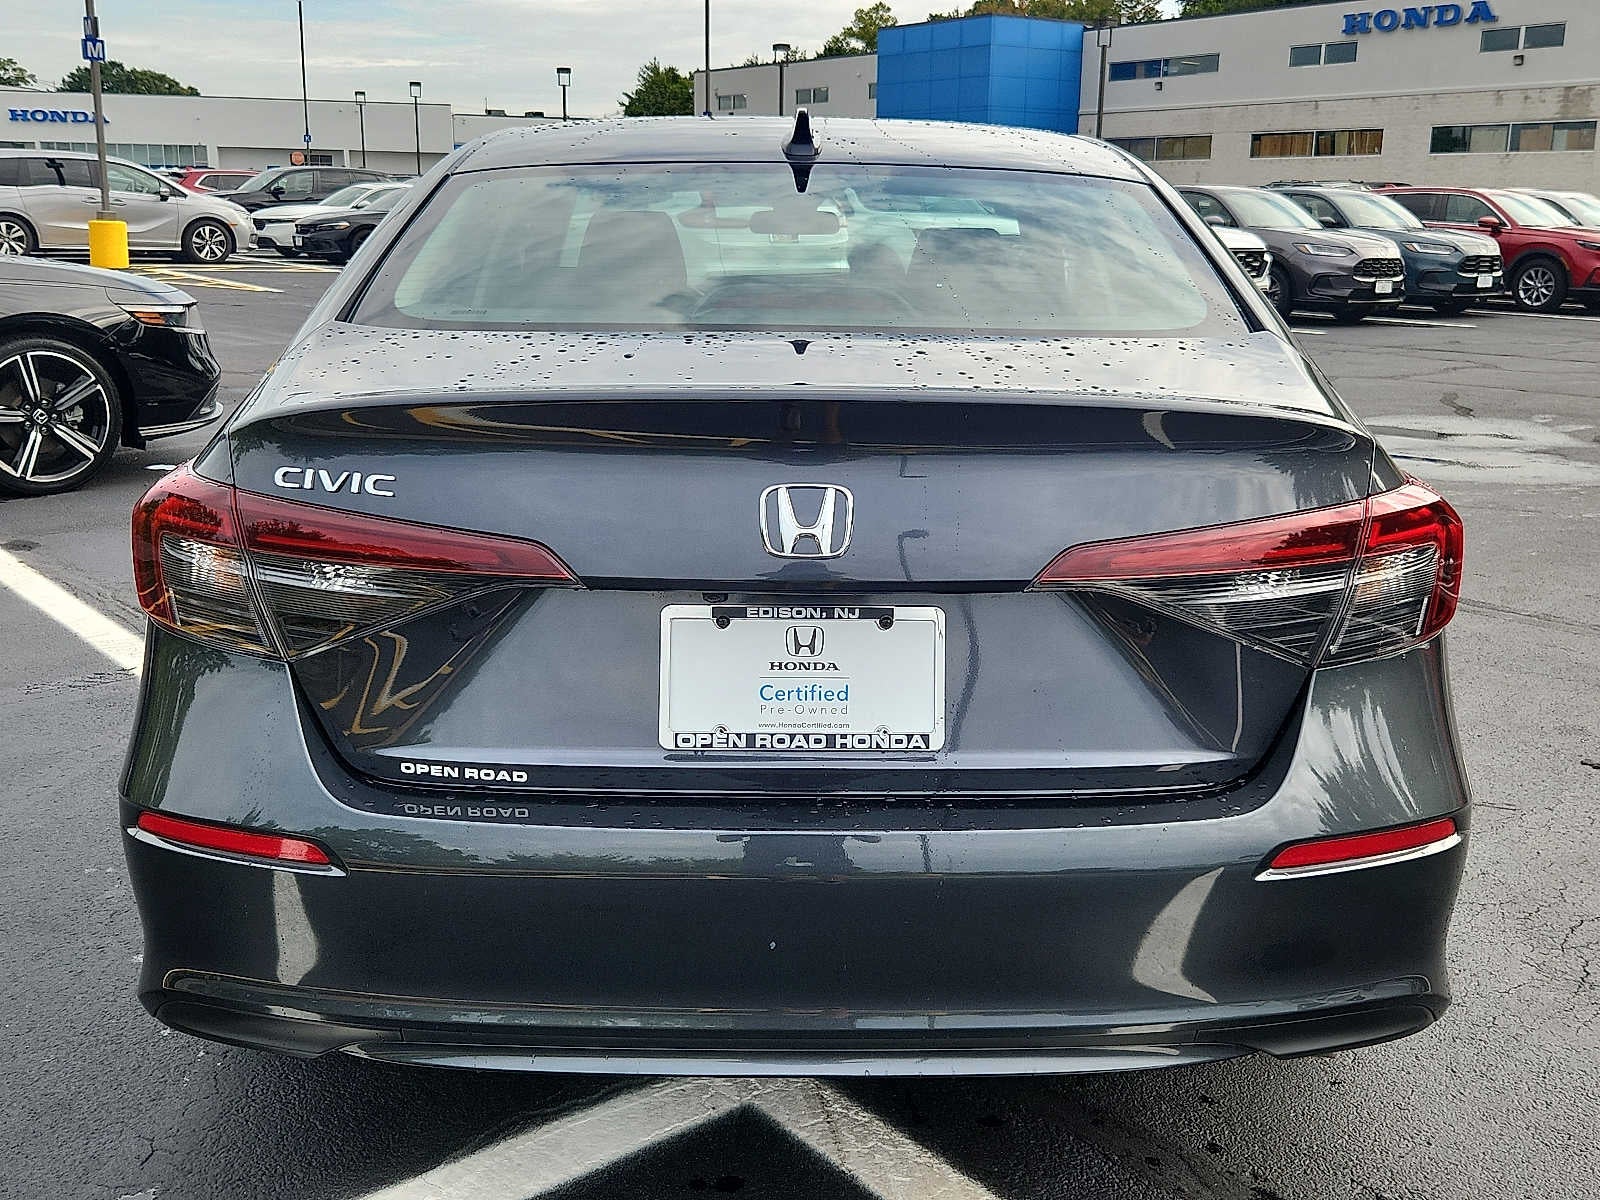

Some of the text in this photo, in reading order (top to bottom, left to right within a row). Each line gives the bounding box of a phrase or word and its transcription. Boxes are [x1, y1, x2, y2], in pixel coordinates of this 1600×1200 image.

[1341, 0, 1498, 35] HONDA
[87, 41, 103, 58] M
[274, 466, 396, 497] CIVIC
[746, 607, 860, 619] EDISON, NJ
[768, 661, 841, 671] HONDA
[759, 684, 849, 702] Certified
[760, 704, 848, 715] Pre-Owned
[676, 733, 927, 749] OPEN ROAD HONDA
[400, 762, 528, 783] OPEN ROAD
